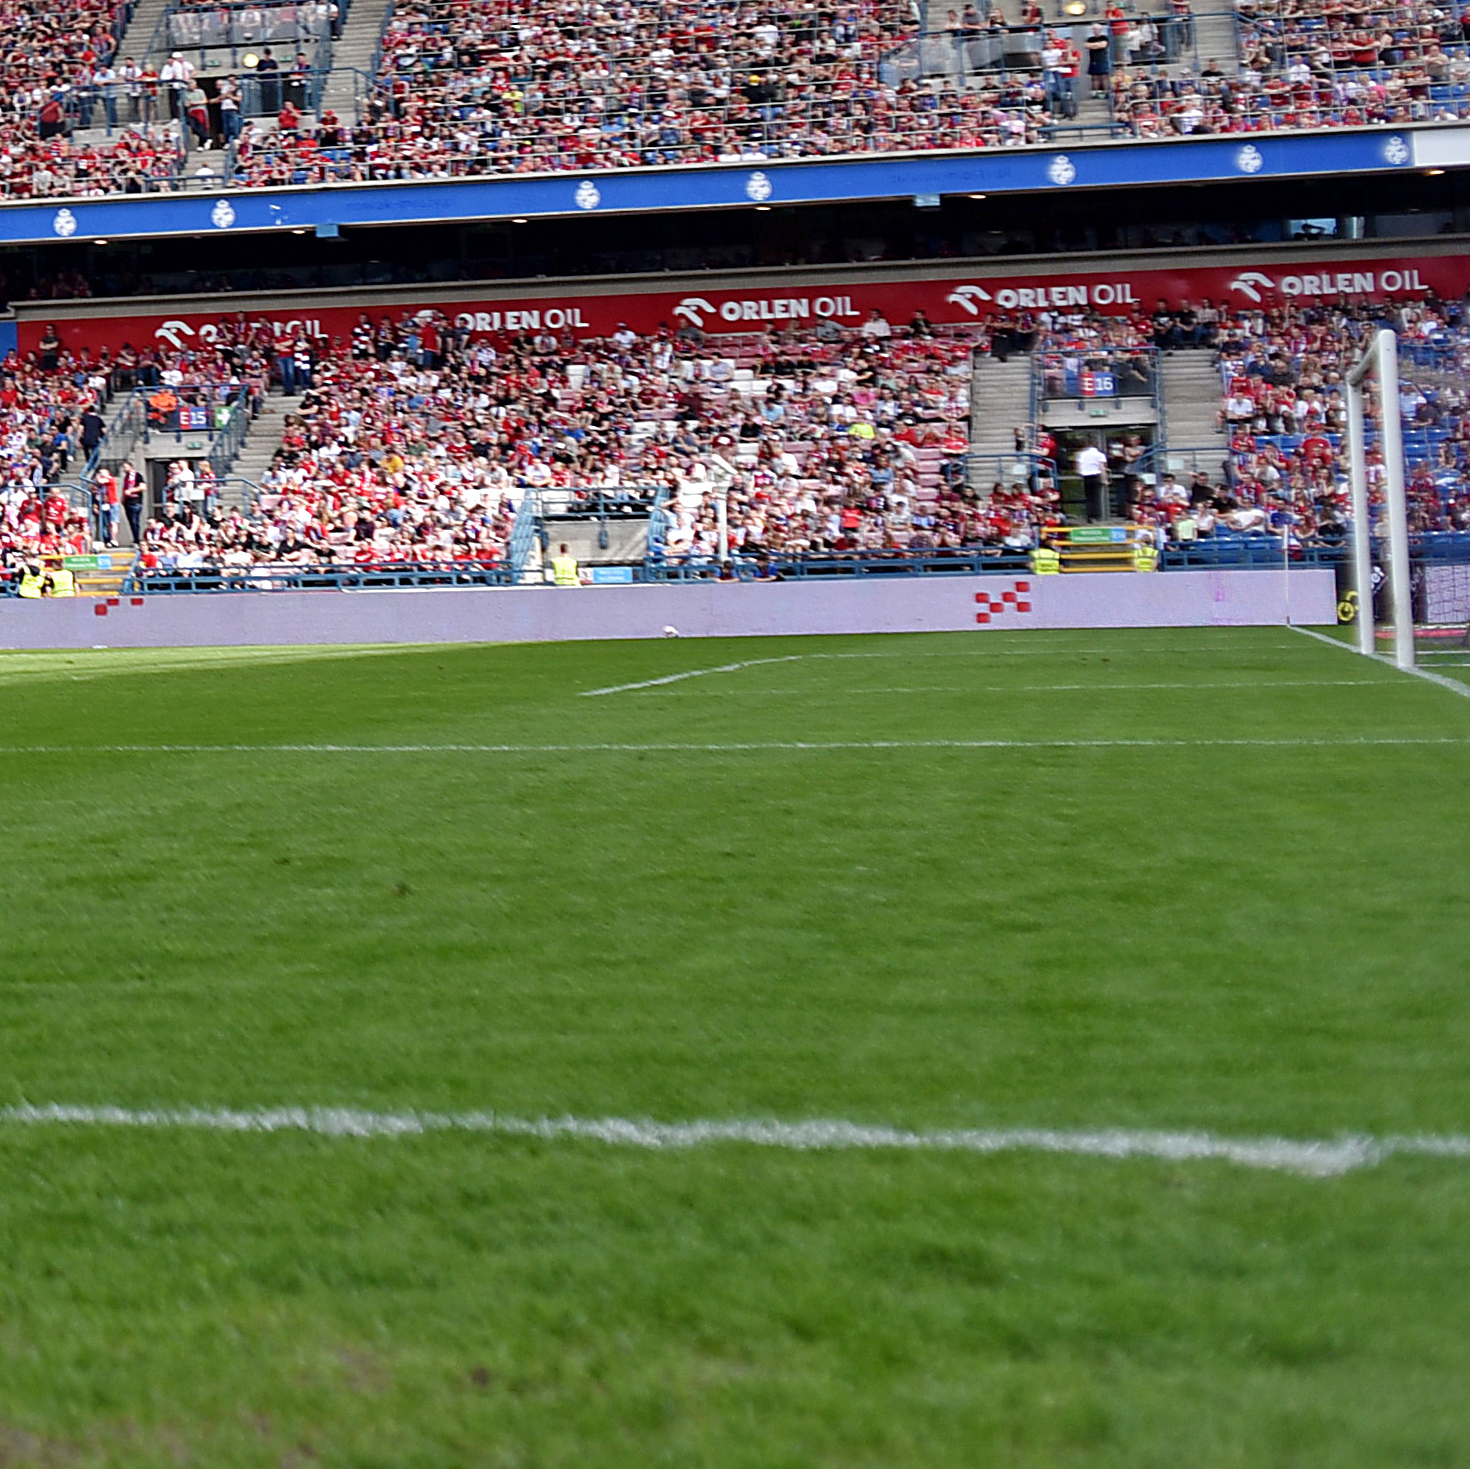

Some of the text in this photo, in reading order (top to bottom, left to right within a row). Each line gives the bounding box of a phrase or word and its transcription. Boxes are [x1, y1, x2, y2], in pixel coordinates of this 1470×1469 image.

[1281, 270, 1429, 296] ORLEN OIL
[996, 283, 1141, 309] ORLEN OIL
[544, 308, 590, 329] OIL
[720, 296, 861, 321] ORLEN OIL
[1083, 377, 1113, 391] E16
[180, 412, 206, 426] E15
